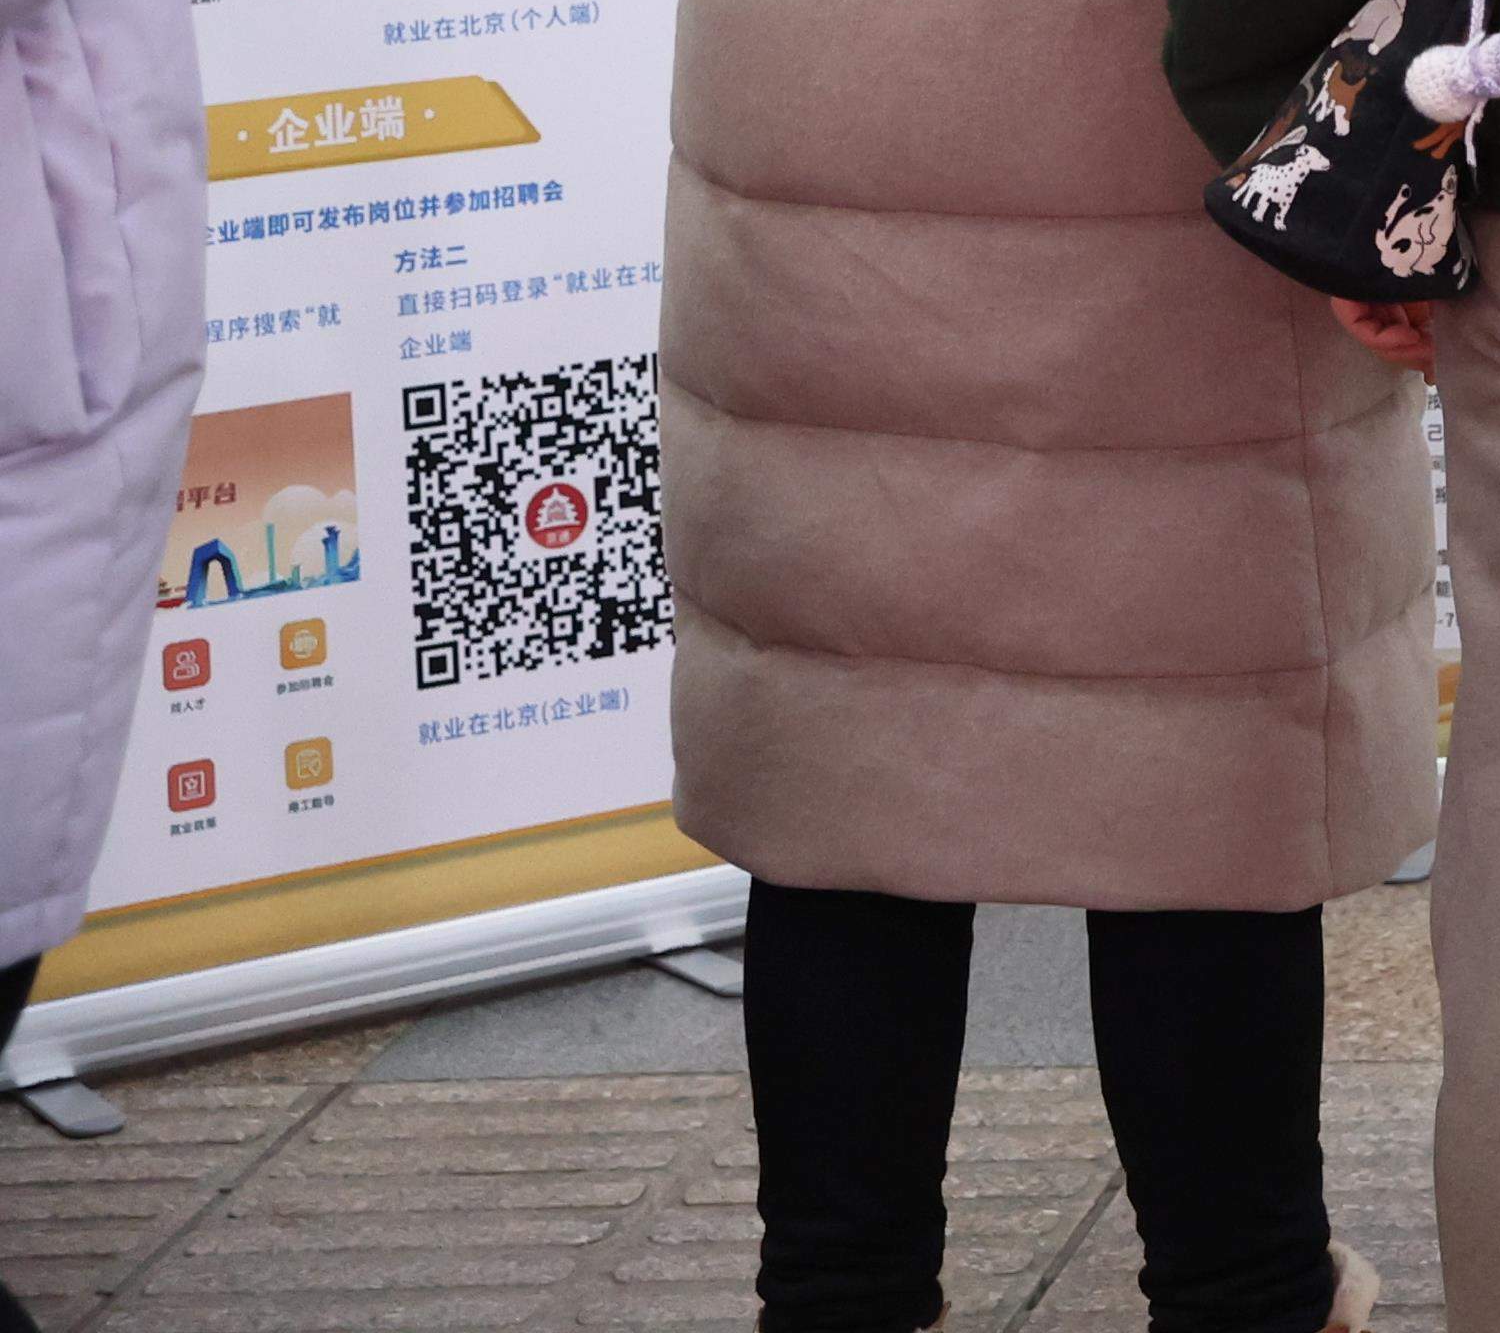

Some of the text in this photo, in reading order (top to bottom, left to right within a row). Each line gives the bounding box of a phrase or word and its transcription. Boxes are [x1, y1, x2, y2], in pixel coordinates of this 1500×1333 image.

[383, 0, 600, 45] 就业在北京(个人端)
[267, 94, 406, 154] 企业端
[394, 244, 468, 274] 方法二
[399, 329, 472, 360] 企业端
[417, 686, 630, 747] 就业在北京(企业端)
